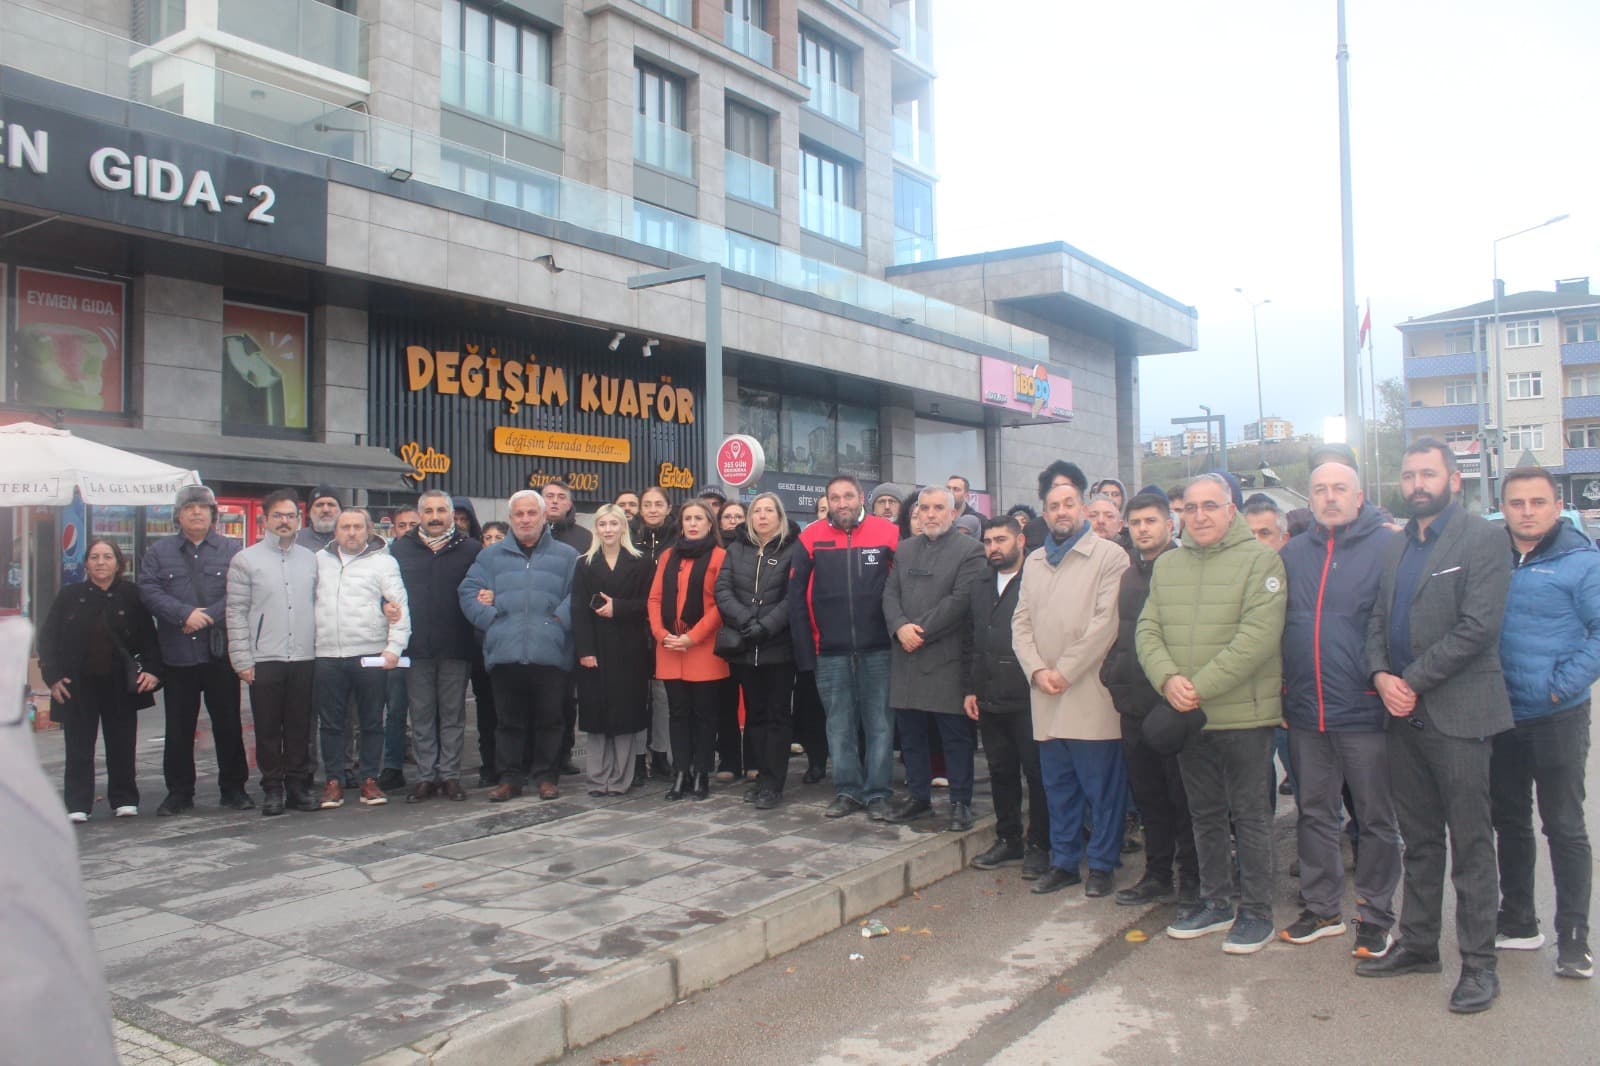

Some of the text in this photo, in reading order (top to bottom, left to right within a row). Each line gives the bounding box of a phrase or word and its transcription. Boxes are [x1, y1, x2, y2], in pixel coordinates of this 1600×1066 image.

[90, 146, 276, 224] GIDA-2
[27, 290, 115, 316] EYMEN GIDA
[406, 343, 695, 425] DEĞİŞİM KUAFÖR
[505, 432, 545, 452] değişim
[547, 435, 582, 452] burada
[90, 482, 176, 494] LA GELATERIA
[568, 472, 599, 491] 2003
